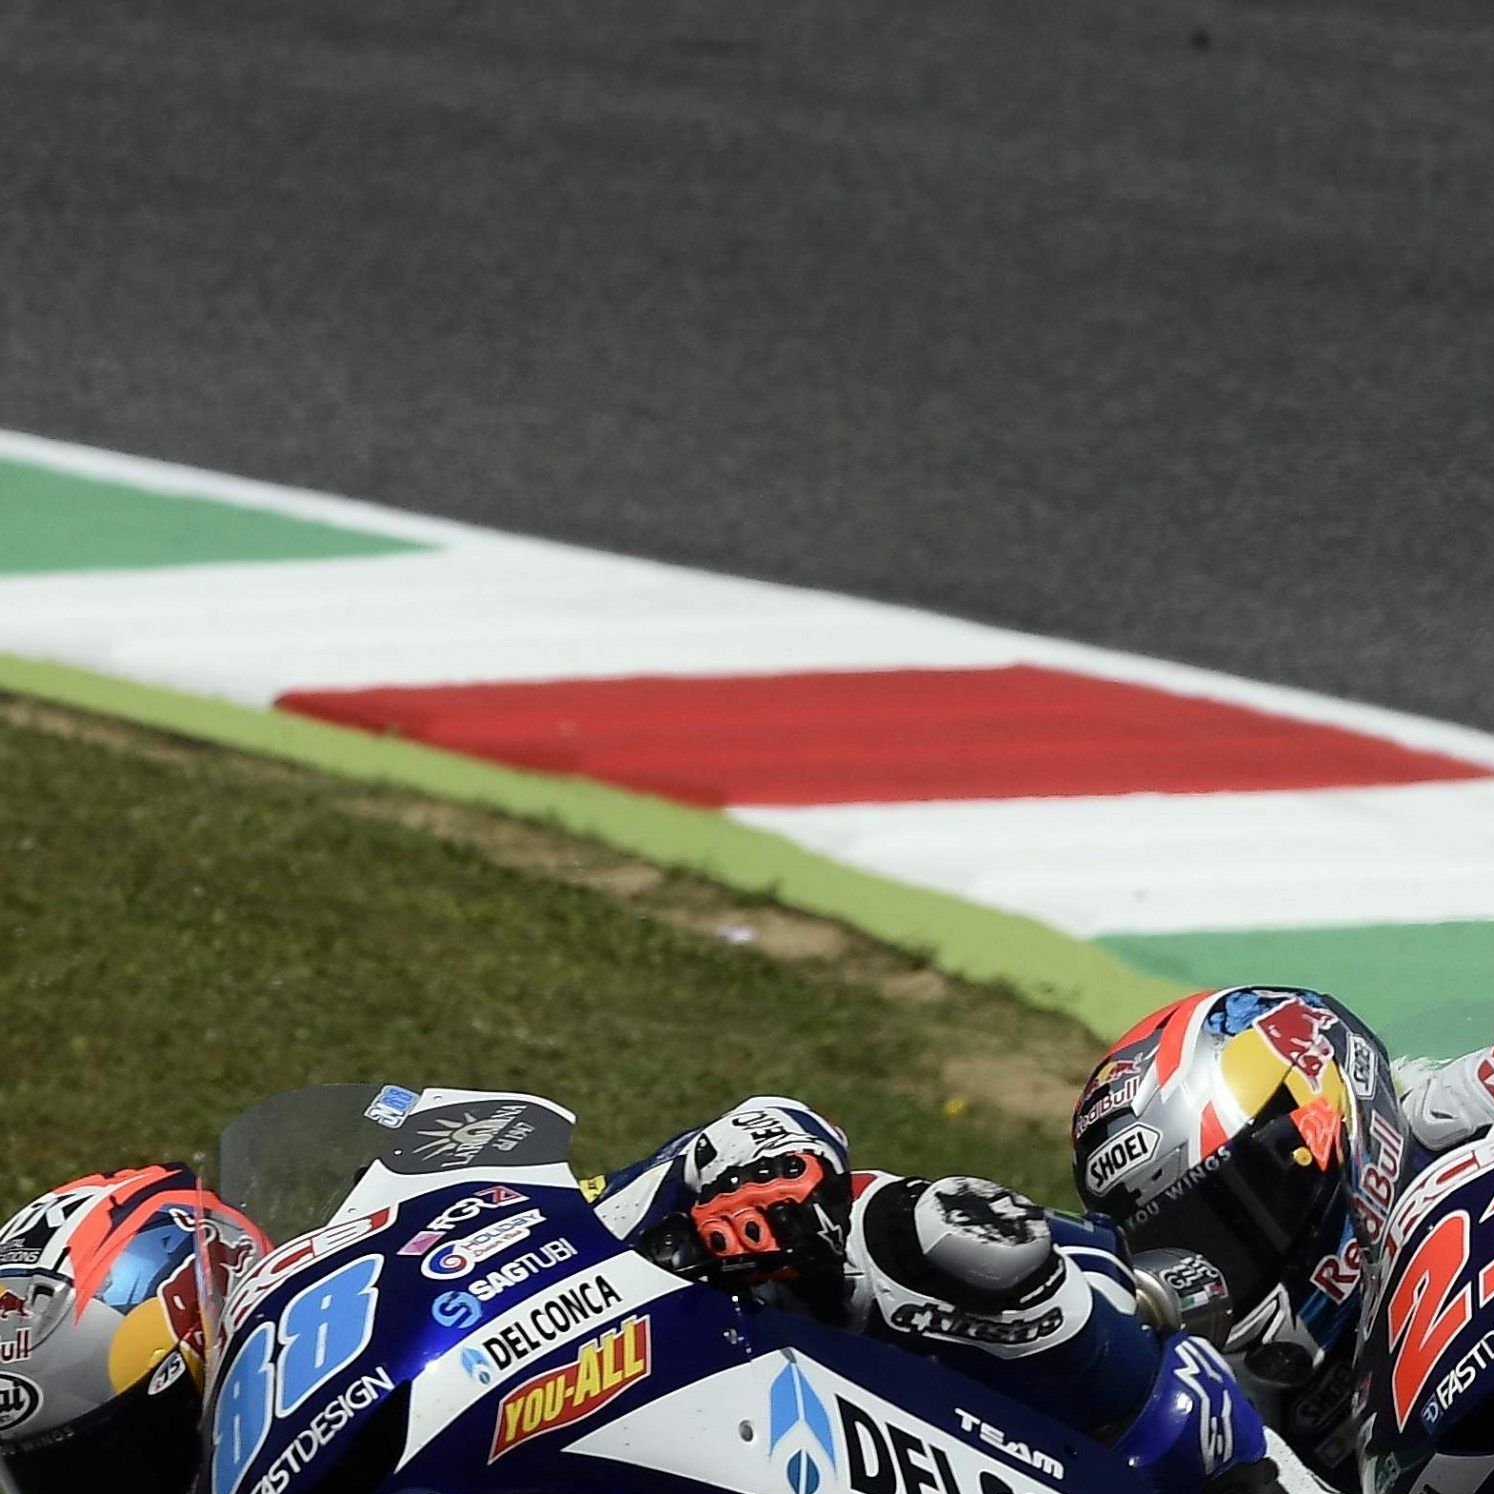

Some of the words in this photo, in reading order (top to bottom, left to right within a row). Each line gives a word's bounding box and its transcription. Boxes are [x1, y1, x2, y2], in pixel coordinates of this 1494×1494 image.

[1090, 1131, 1149, 1189] SHOEI
[1165, 1145, 1232, 1200] WINGS
[468, 1237, 579, 1301] SAGTUBI
[504, 1317, 646, 1442] YOU-ALL
[954, 1408, 1065, 1480] TEAM
